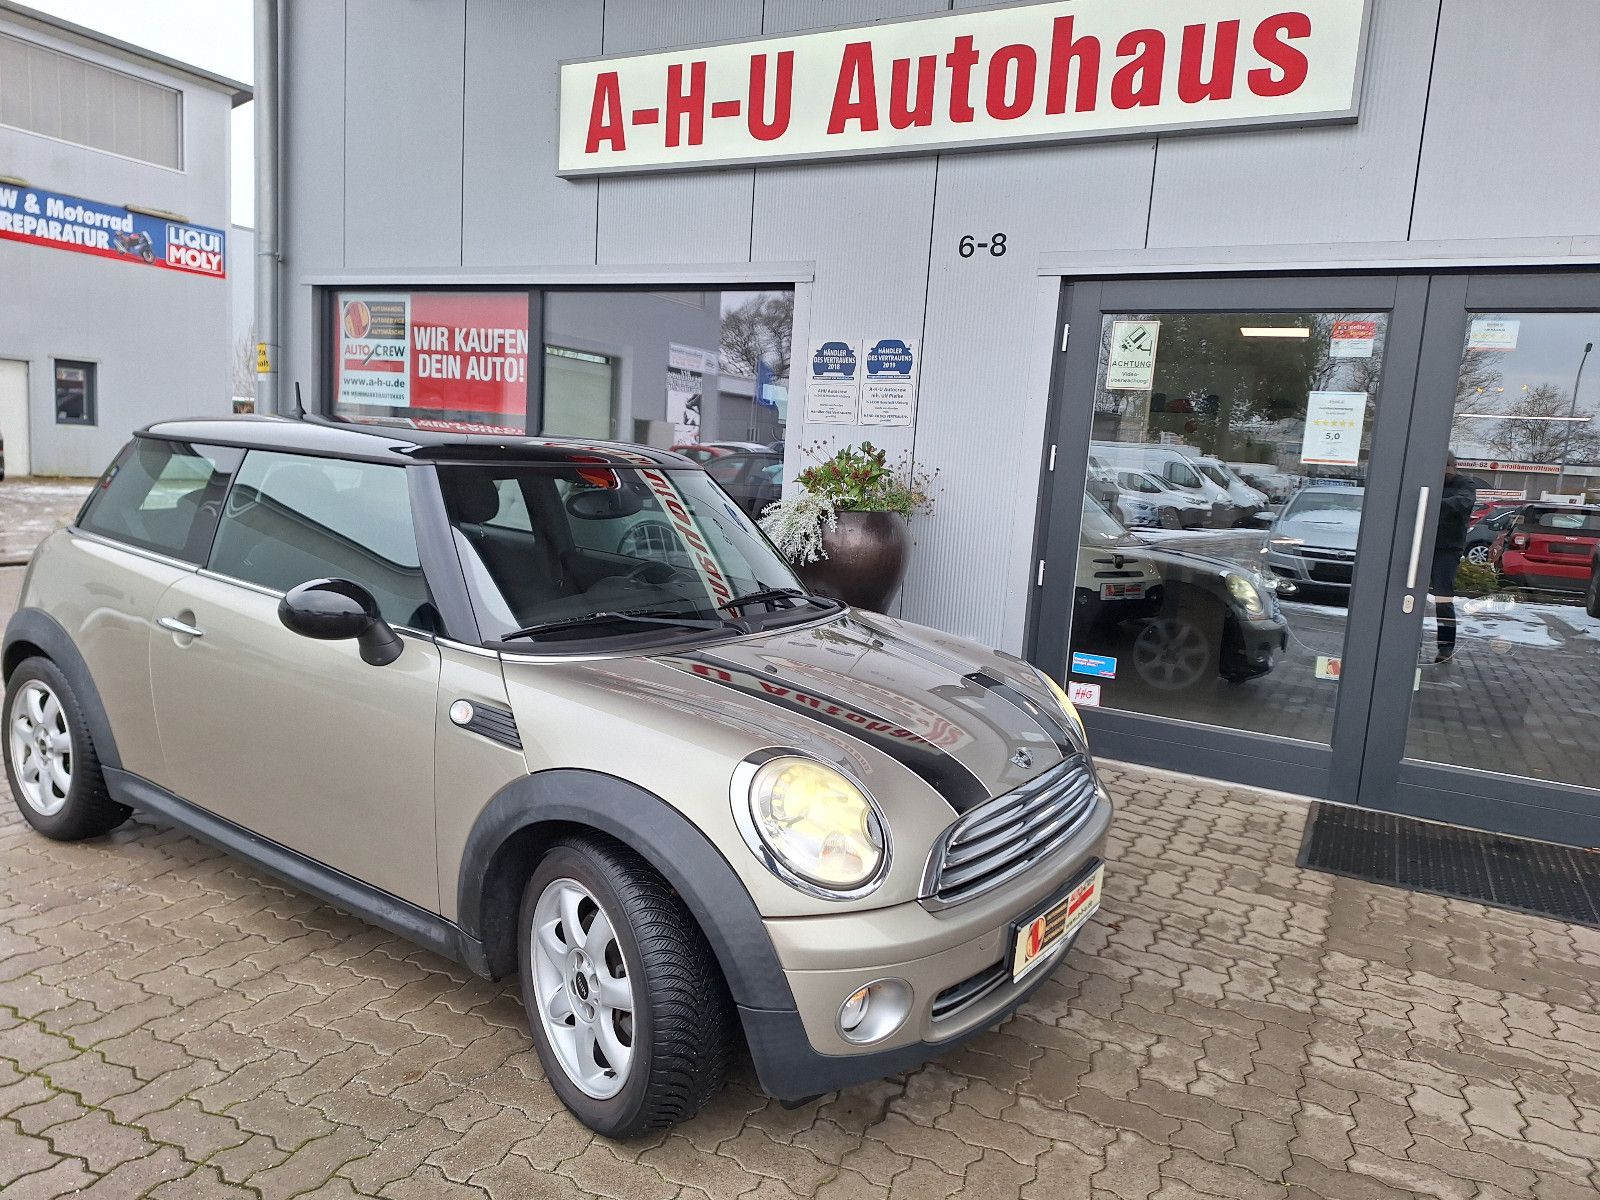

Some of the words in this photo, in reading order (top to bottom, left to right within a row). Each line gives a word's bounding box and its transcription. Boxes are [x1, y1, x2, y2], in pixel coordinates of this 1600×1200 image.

[585, 51, 794, 153] A-H-U
[827, 11, 1312, 135] Autohaus
[24, 193, 40, 214] &
[46, 198, 134, 233] Motorrad
[0, 211, 110, 250] REPARATUR
[169, 226, 221, 252] LIQUI
[958, 233, 1008, 258] 6-8
[169, 247, 222, 271] MOLY
[375, 344, 406, 357] CREW
[413, 326, 449, 351] WIR
[454, 327, 528, 354] KAUFEN
[823, 348, 847, 356] HÄNDLER
[418, 353, 461, 380] DEIN
[466, 355, 525, 382] AUTO!
[1112, 360, 1152, 368] ACHTUNG
[343, 377, 406, 388] www.a-h-u.de
[1325, 432, 1341, 441] 5,0
